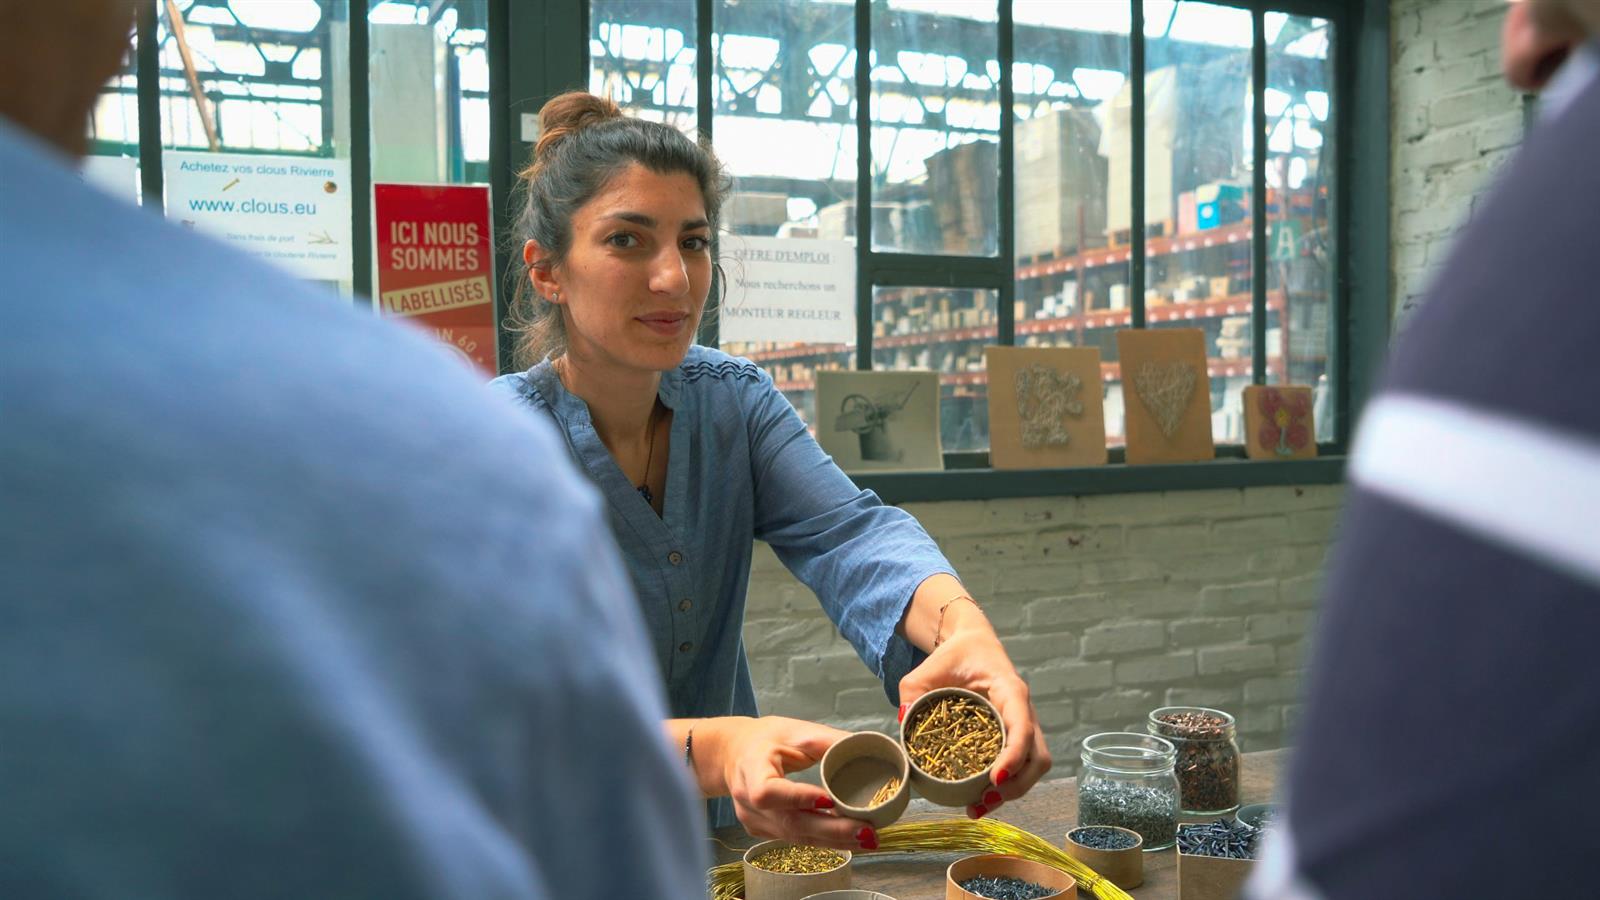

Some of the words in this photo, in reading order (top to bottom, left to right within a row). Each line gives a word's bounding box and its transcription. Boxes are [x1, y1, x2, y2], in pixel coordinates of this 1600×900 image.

[180, 161, 229, 173] Achetez
[232, 165, 253, 174] vos
[256, 164, 287, 175] clous
[290, 166, 335, 177] Rivierre
[189, 199, 317, 216] www.clous.eu
[391, 221, 418, 245] ICI
[424, 221, 479, 246] NOUS
[1276, 227, 1296, 257] A
[391, 247, 479, 271] SOMMES
[734, 249, 773, 261] OFFRE
[775, 251, 830, 264] D'EMPLOI
[736, 279, 761, 289] Nous
[763, 280, 821, 291] recherchons
[389, 279, 484, 313] LABELLISÉS
[725, 307, 785, 318] MONTEUR
[458, 336, 477, 353] 60
